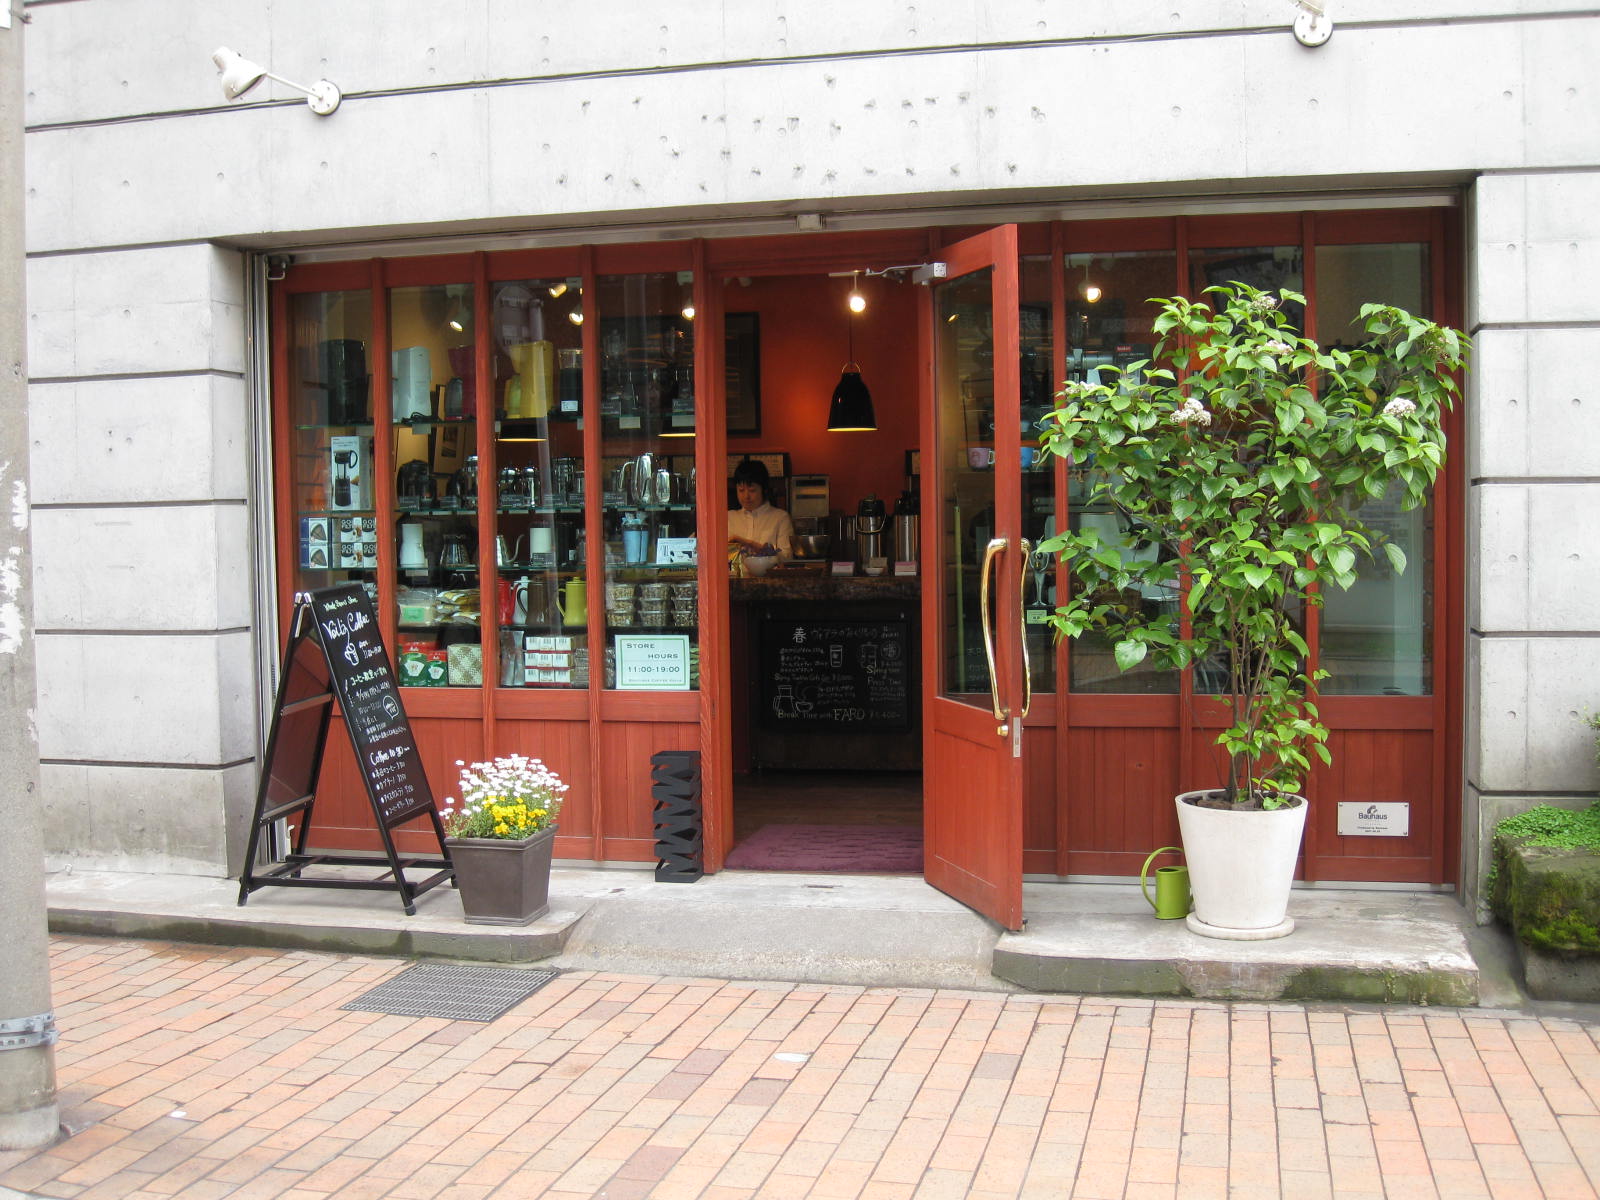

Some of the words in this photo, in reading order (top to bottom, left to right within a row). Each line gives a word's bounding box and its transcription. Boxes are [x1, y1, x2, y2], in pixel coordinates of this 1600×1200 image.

[346, 612, 370, 632] Coffee
[792, 626, 807, 644] 春
[370, 750, 390, 766] Coffee
[1358, 812, 1388, 820] Bauhaus
